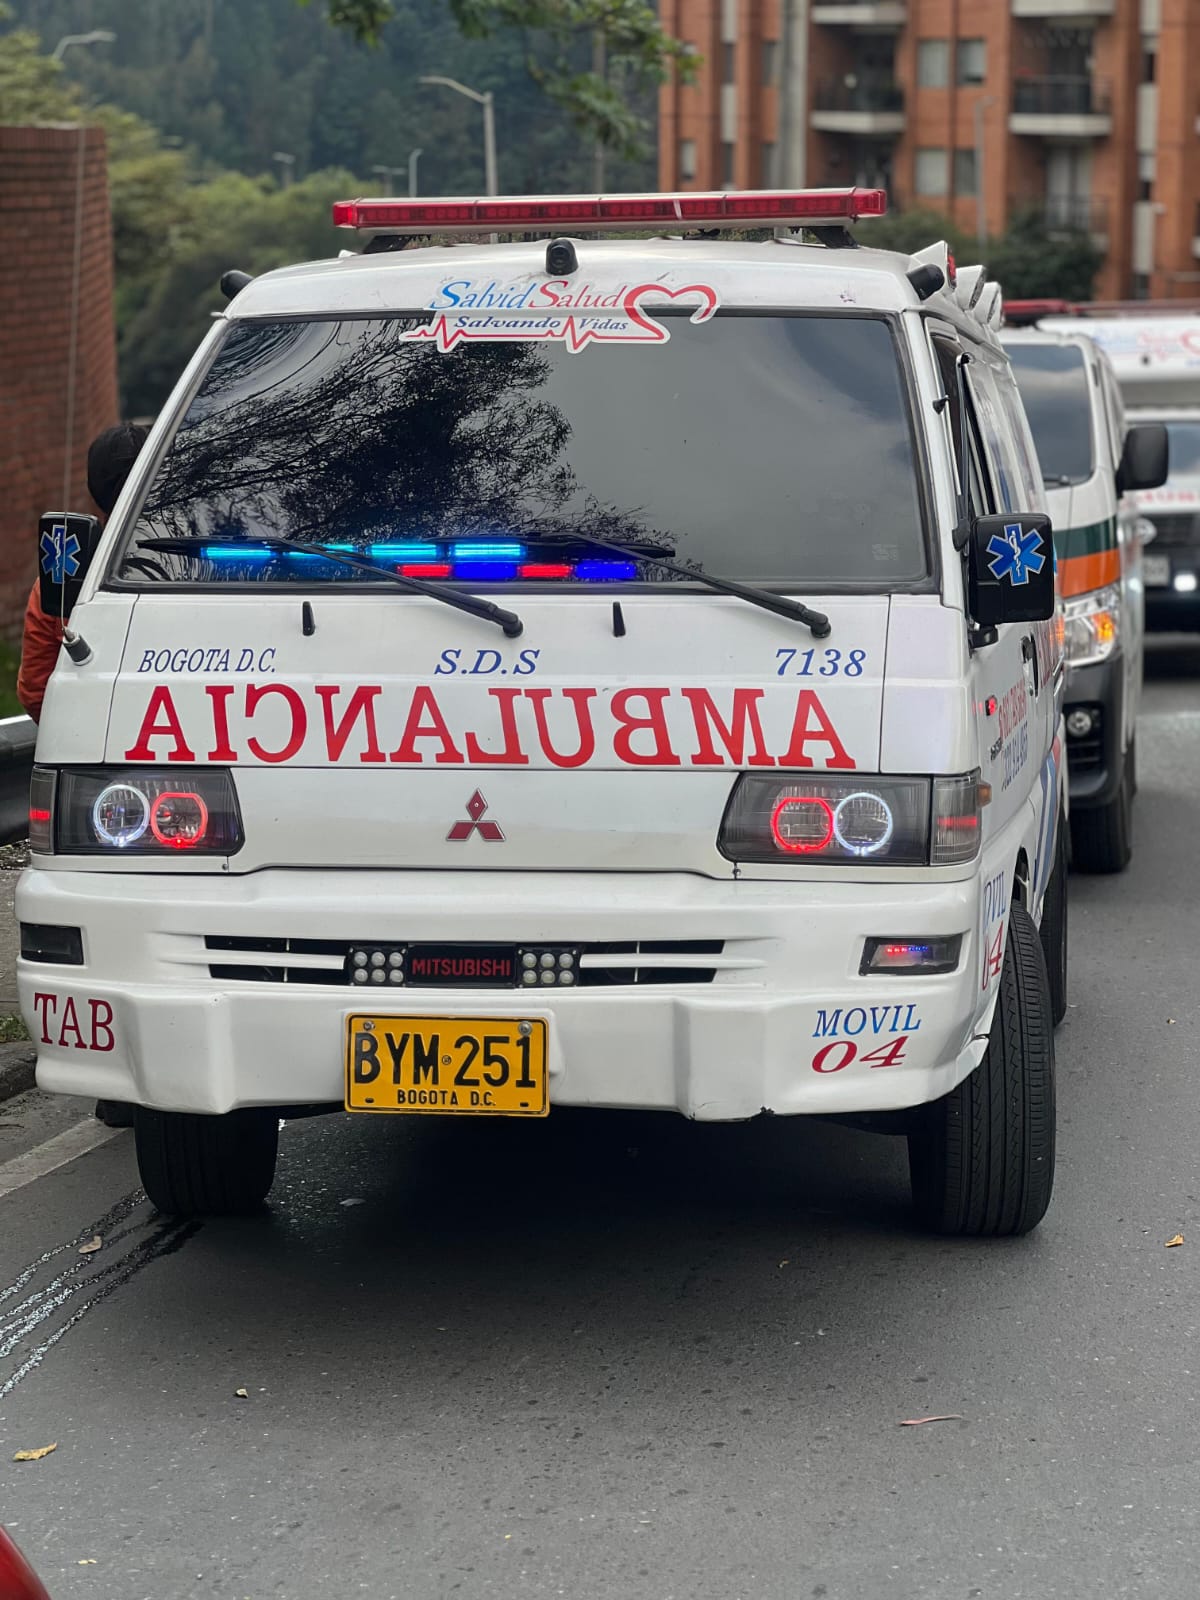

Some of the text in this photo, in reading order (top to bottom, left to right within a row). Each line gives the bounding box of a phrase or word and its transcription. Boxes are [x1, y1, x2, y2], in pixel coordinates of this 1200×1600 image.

[454, 315, 629, 330] Salvando Vidas
[137, 648, 277, 673] BOGOTA D.C.
[434, 649, 540, 675] S.D.S
[776, 648, 866, 677] 7138
[411, 958, 511, 977] MITSUBISHI
[34, 992, 115, 1052] TAB
[812, 1004, 921, 1037] MOVIL
[354, 1032, 536, 1088] BYM 251
[811, 1035, 909, 1073] 04
[397, 1089, 496, 1106] BOGOTA D.C.
